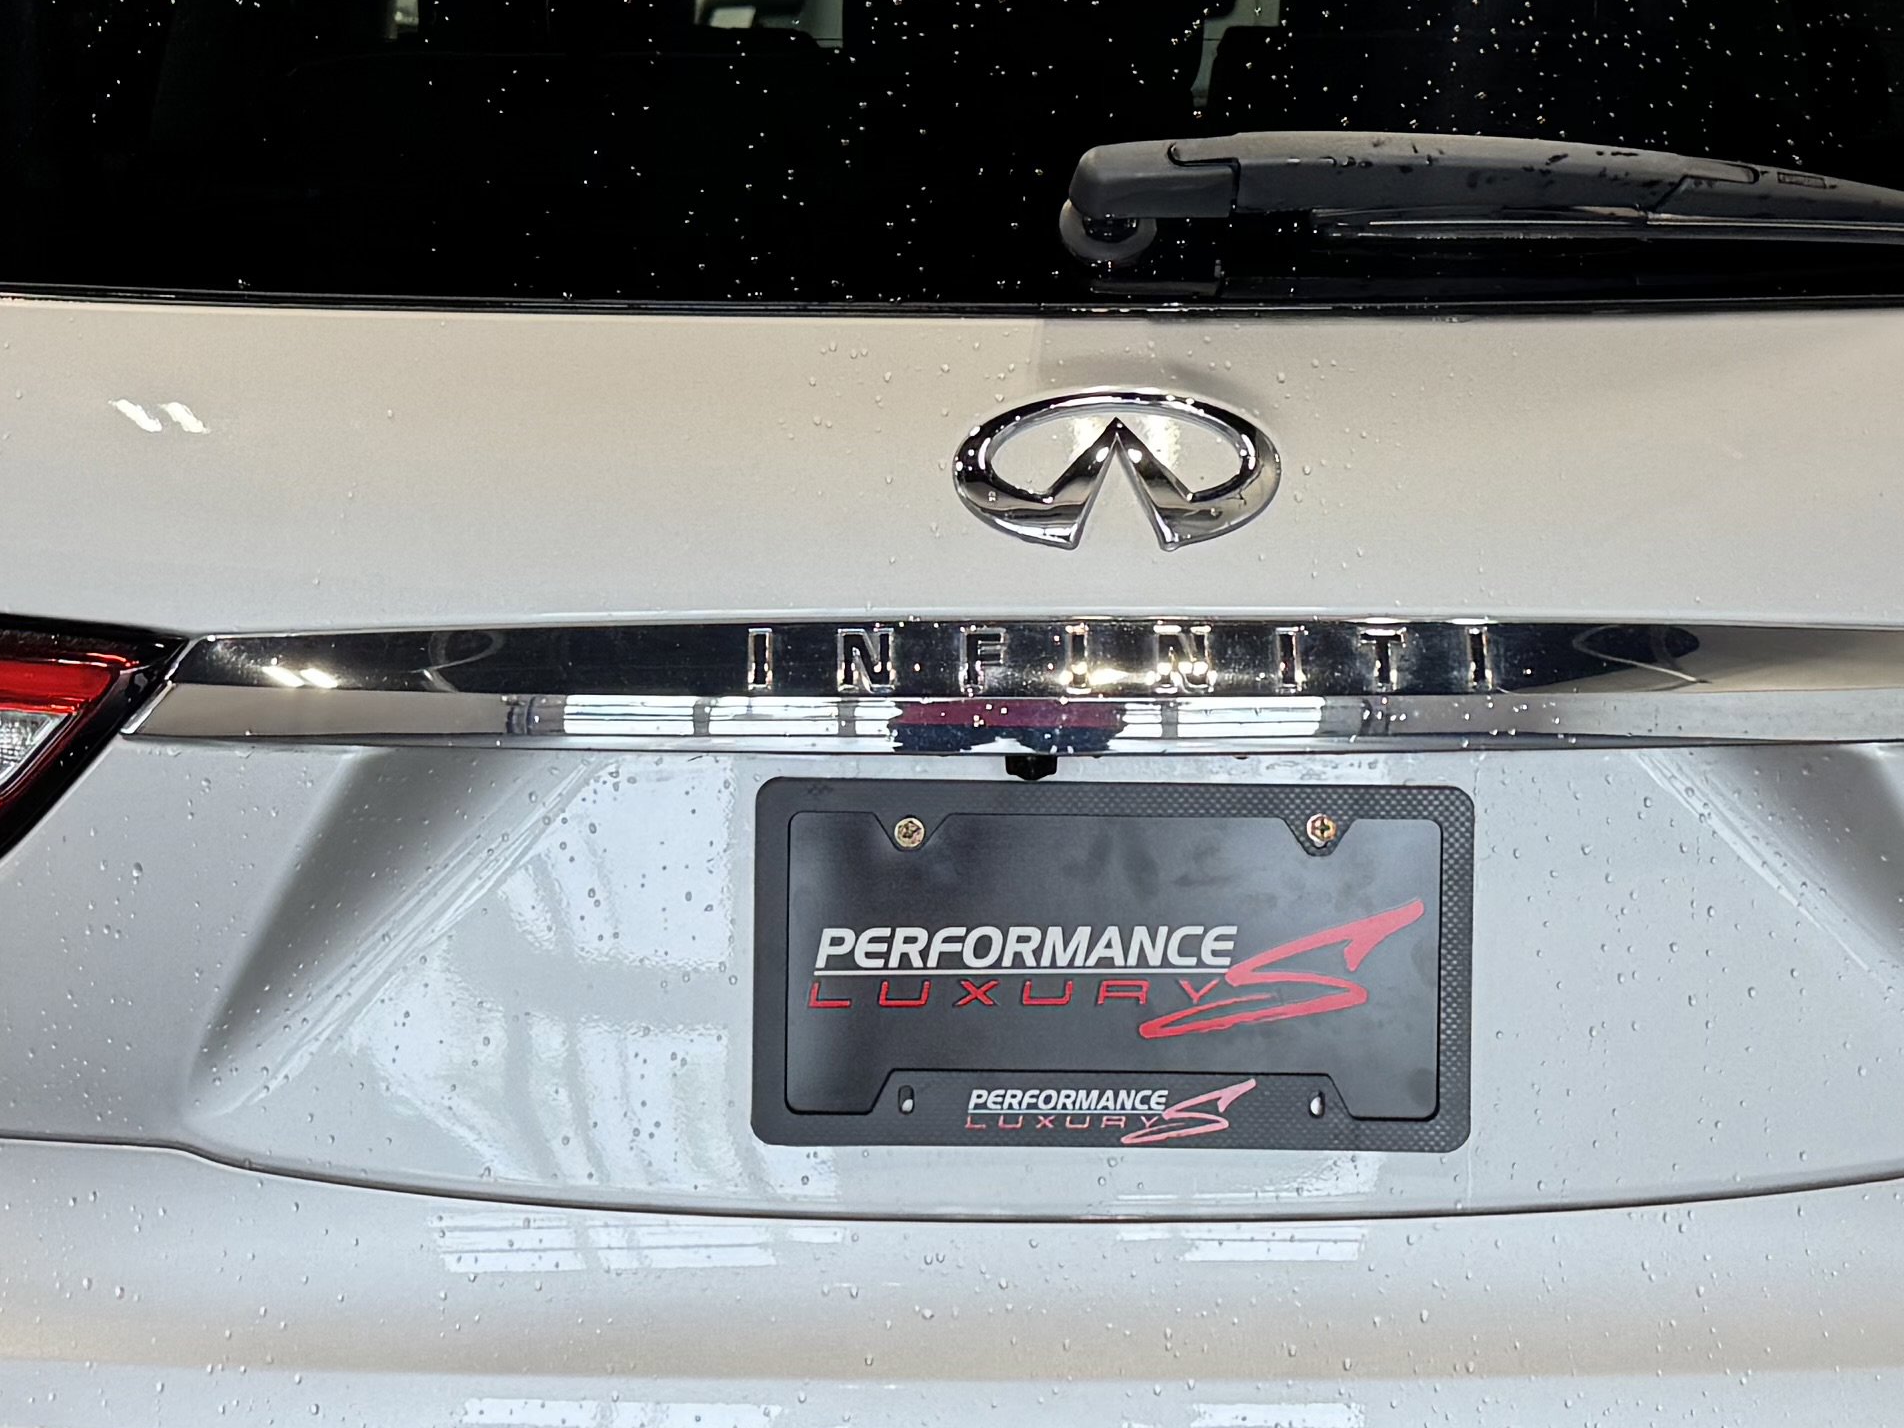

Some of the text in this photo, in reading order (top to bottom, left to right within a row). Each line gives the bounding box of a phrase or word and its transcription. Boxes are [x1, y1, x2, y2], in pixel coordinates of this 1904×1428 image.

[747, 626, 1492, 693] INFINITI
[814, 925, 1238, 969] PERFORMANCE
[807, 979, 1219, 1008] LUXURY
[967, 1088, 1169, 1111] PERFORMANCE
[964, 1115, 1158, 1129] LUXURY
